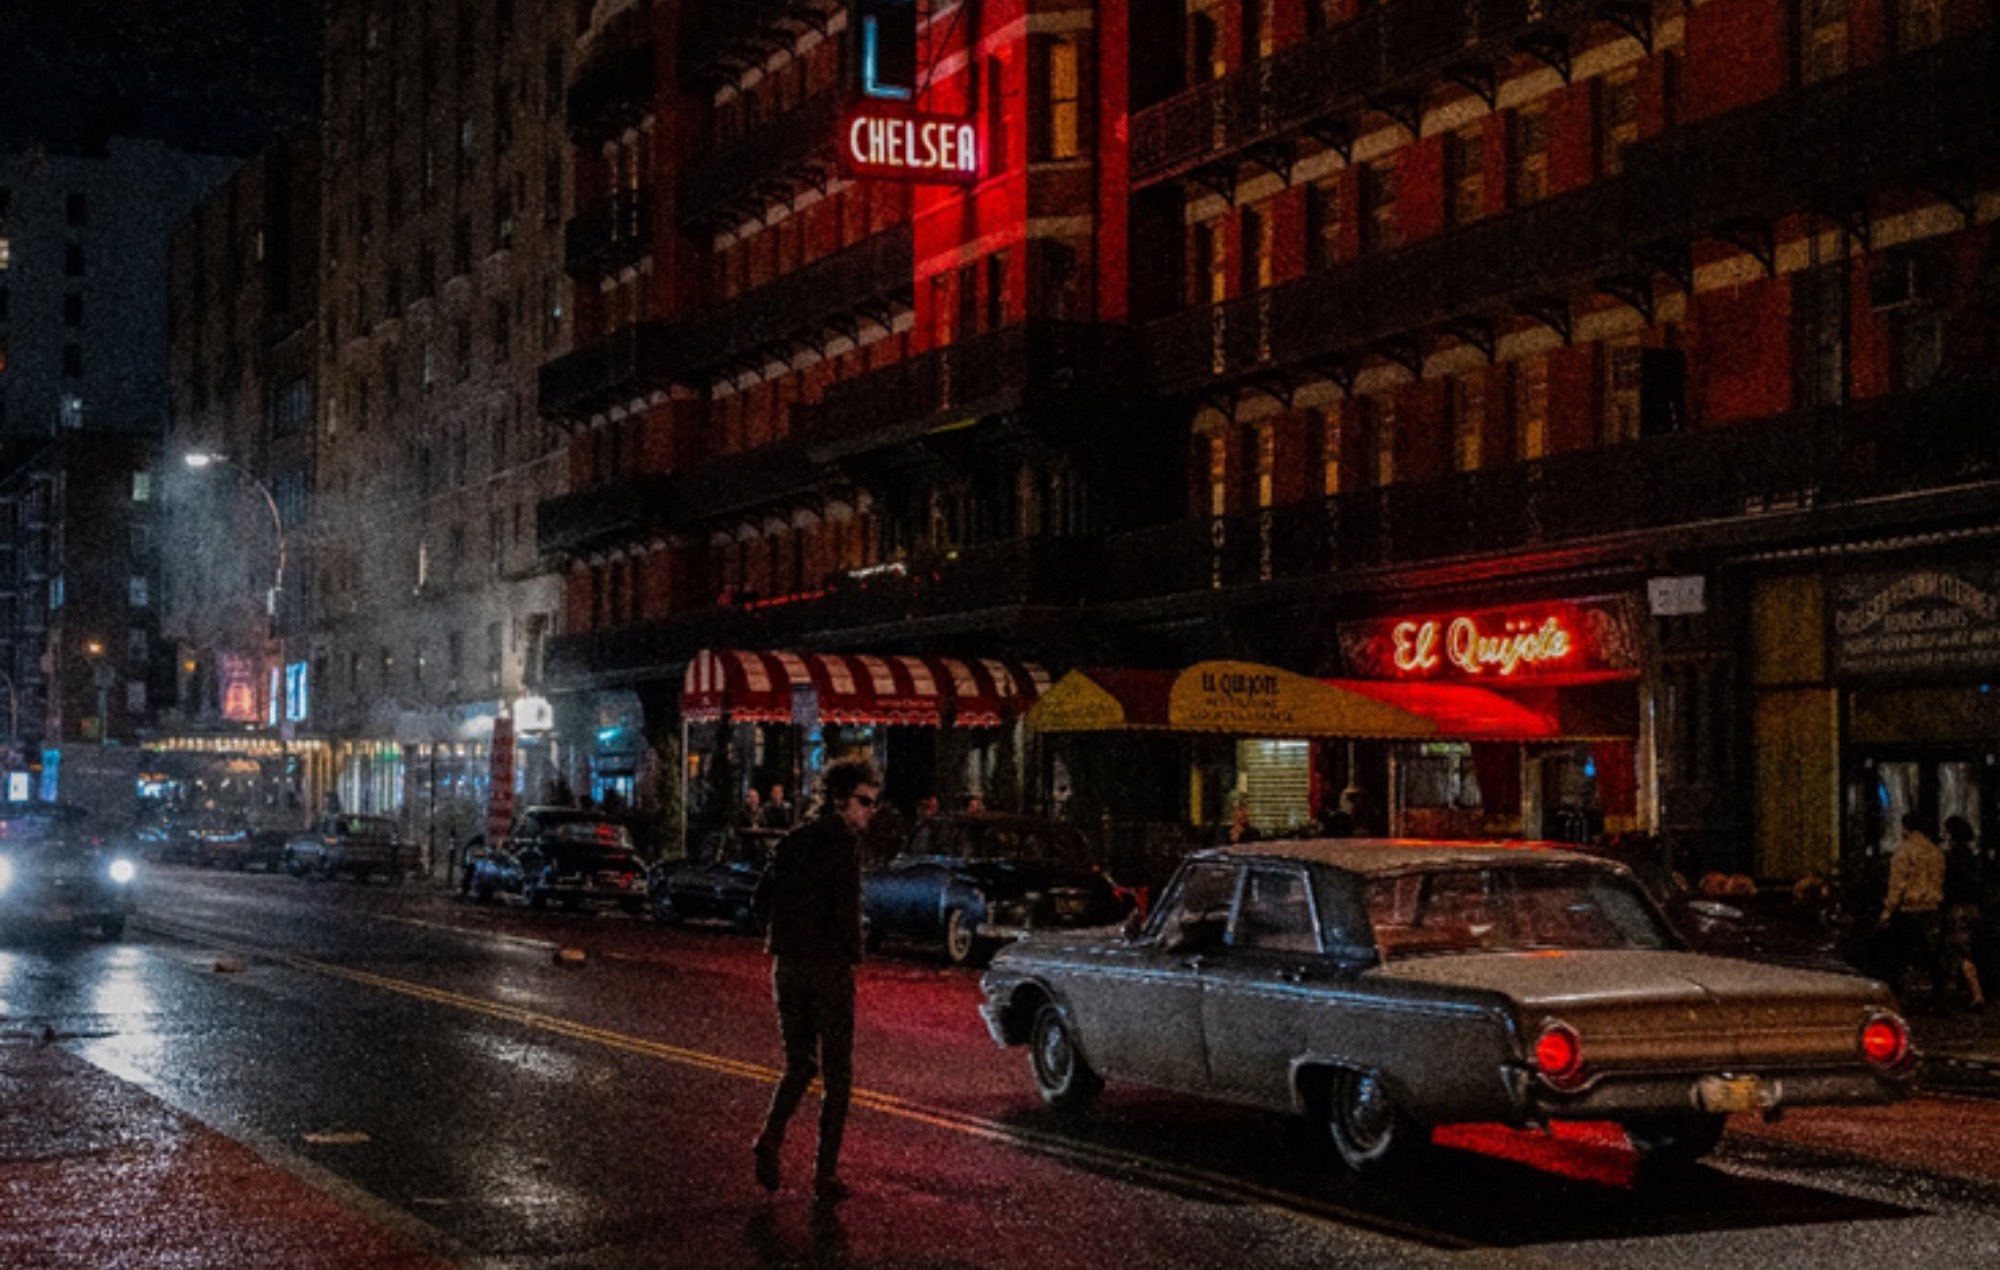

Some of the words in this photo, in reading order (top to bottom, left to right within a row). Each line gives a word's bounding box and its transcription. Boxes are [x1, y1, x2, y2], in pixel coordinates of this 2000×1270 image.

[850, 116, 976, 172] CHELSEA
[1391, 619, 1442, 671] El
[1446, 616, 1571, 675] Quijote
[1220, 674, 1279, 698] QUIJOTE
